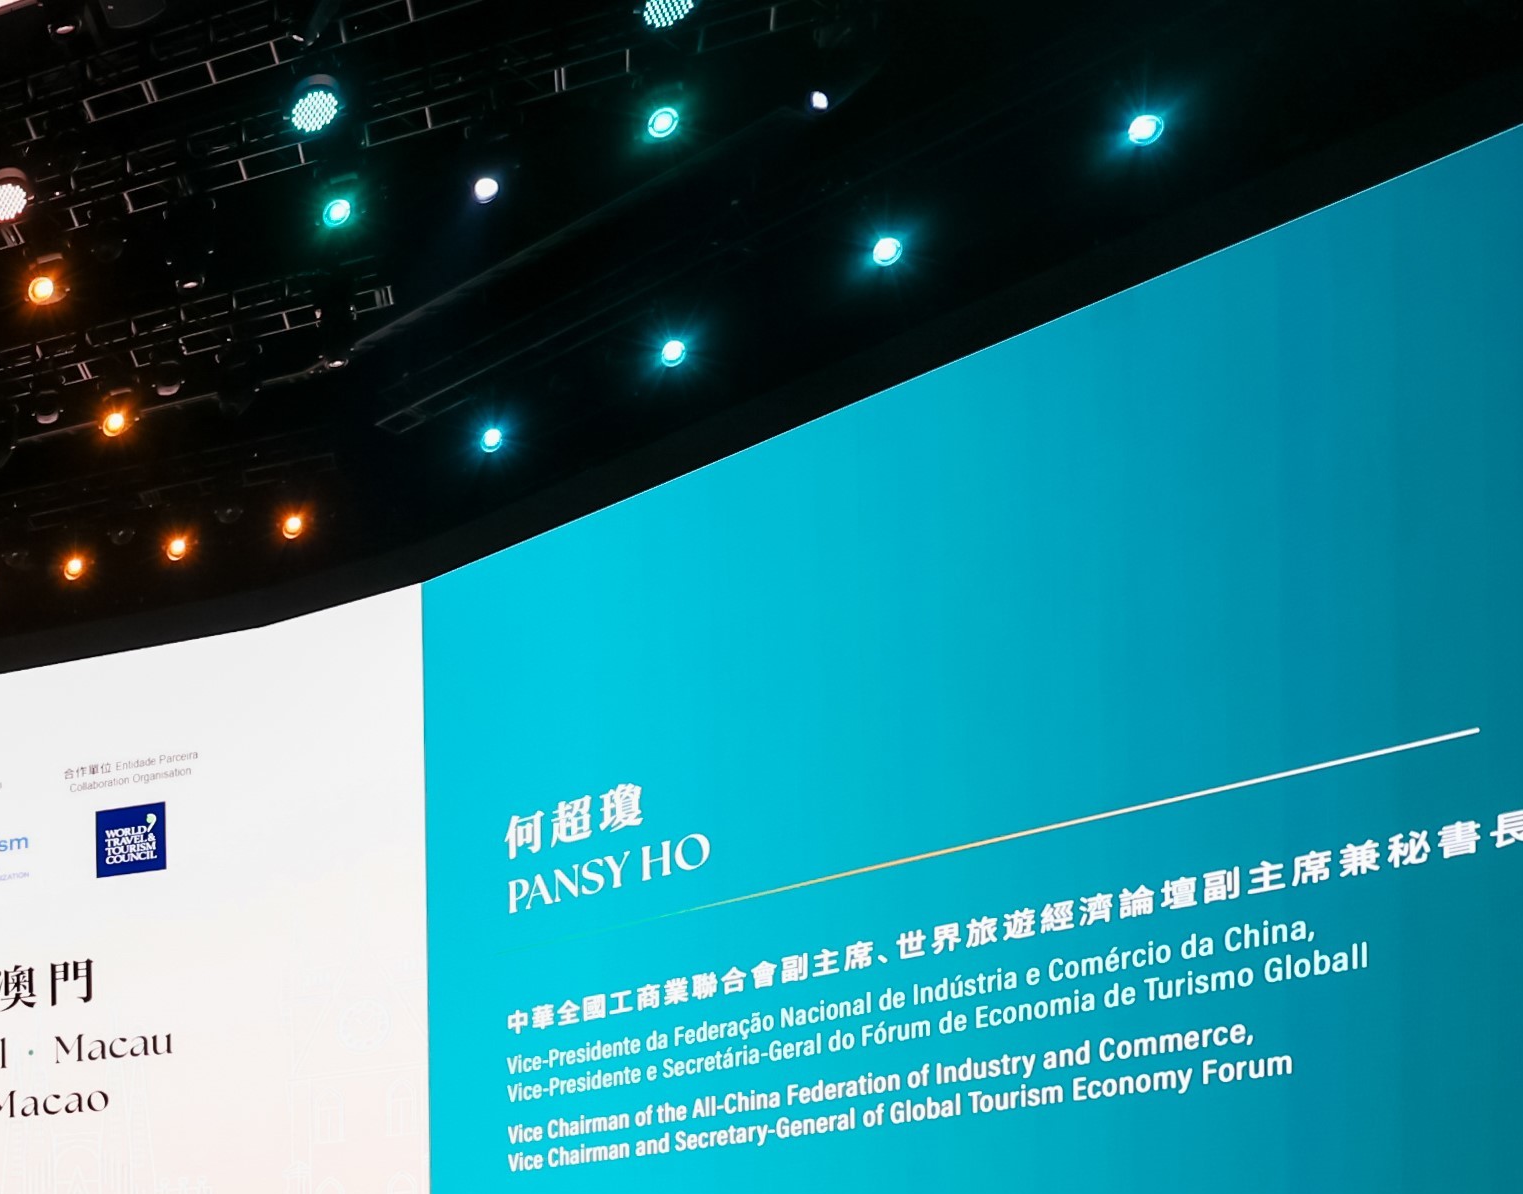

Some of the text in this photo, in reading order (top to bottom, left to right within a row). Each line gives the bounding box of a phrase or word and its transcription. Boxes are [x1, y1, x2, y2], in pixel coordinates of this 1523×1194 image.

[116, 756, 156, 772] Entidade
[159, 750, 198, 766] Parceira
[70, 766, 191, 793] Collaboration Organisation
[105, 826, 147, 838] WORLD
[504, 783, 643, 860] 何超瓊
[105, 834, 147, 847] TRAVEL
[105, 841, 156, 856] TOURISM
[105, 850, 157, 865] COUNCIL
[508, 833, 710, 914] PANSY HO
[506, 920, 1314, 1074] Vice-Presidente da Federação Nacional de Indústria e Comércio da China,
[507, 942, 1367, 1102] Vice-Presidente e Secretária-Geral do Fórum de Economia de Turismo Globall
[55, 1033, 172, 1064] Macau
[508, 1024, 1253, 1144] Vice Chairman of the All-China Federation of Industry and Commerce,
[508, 1055, 1292, 1172] Vice Chairman and Secretary-General of Global Tourism Economy Forum
